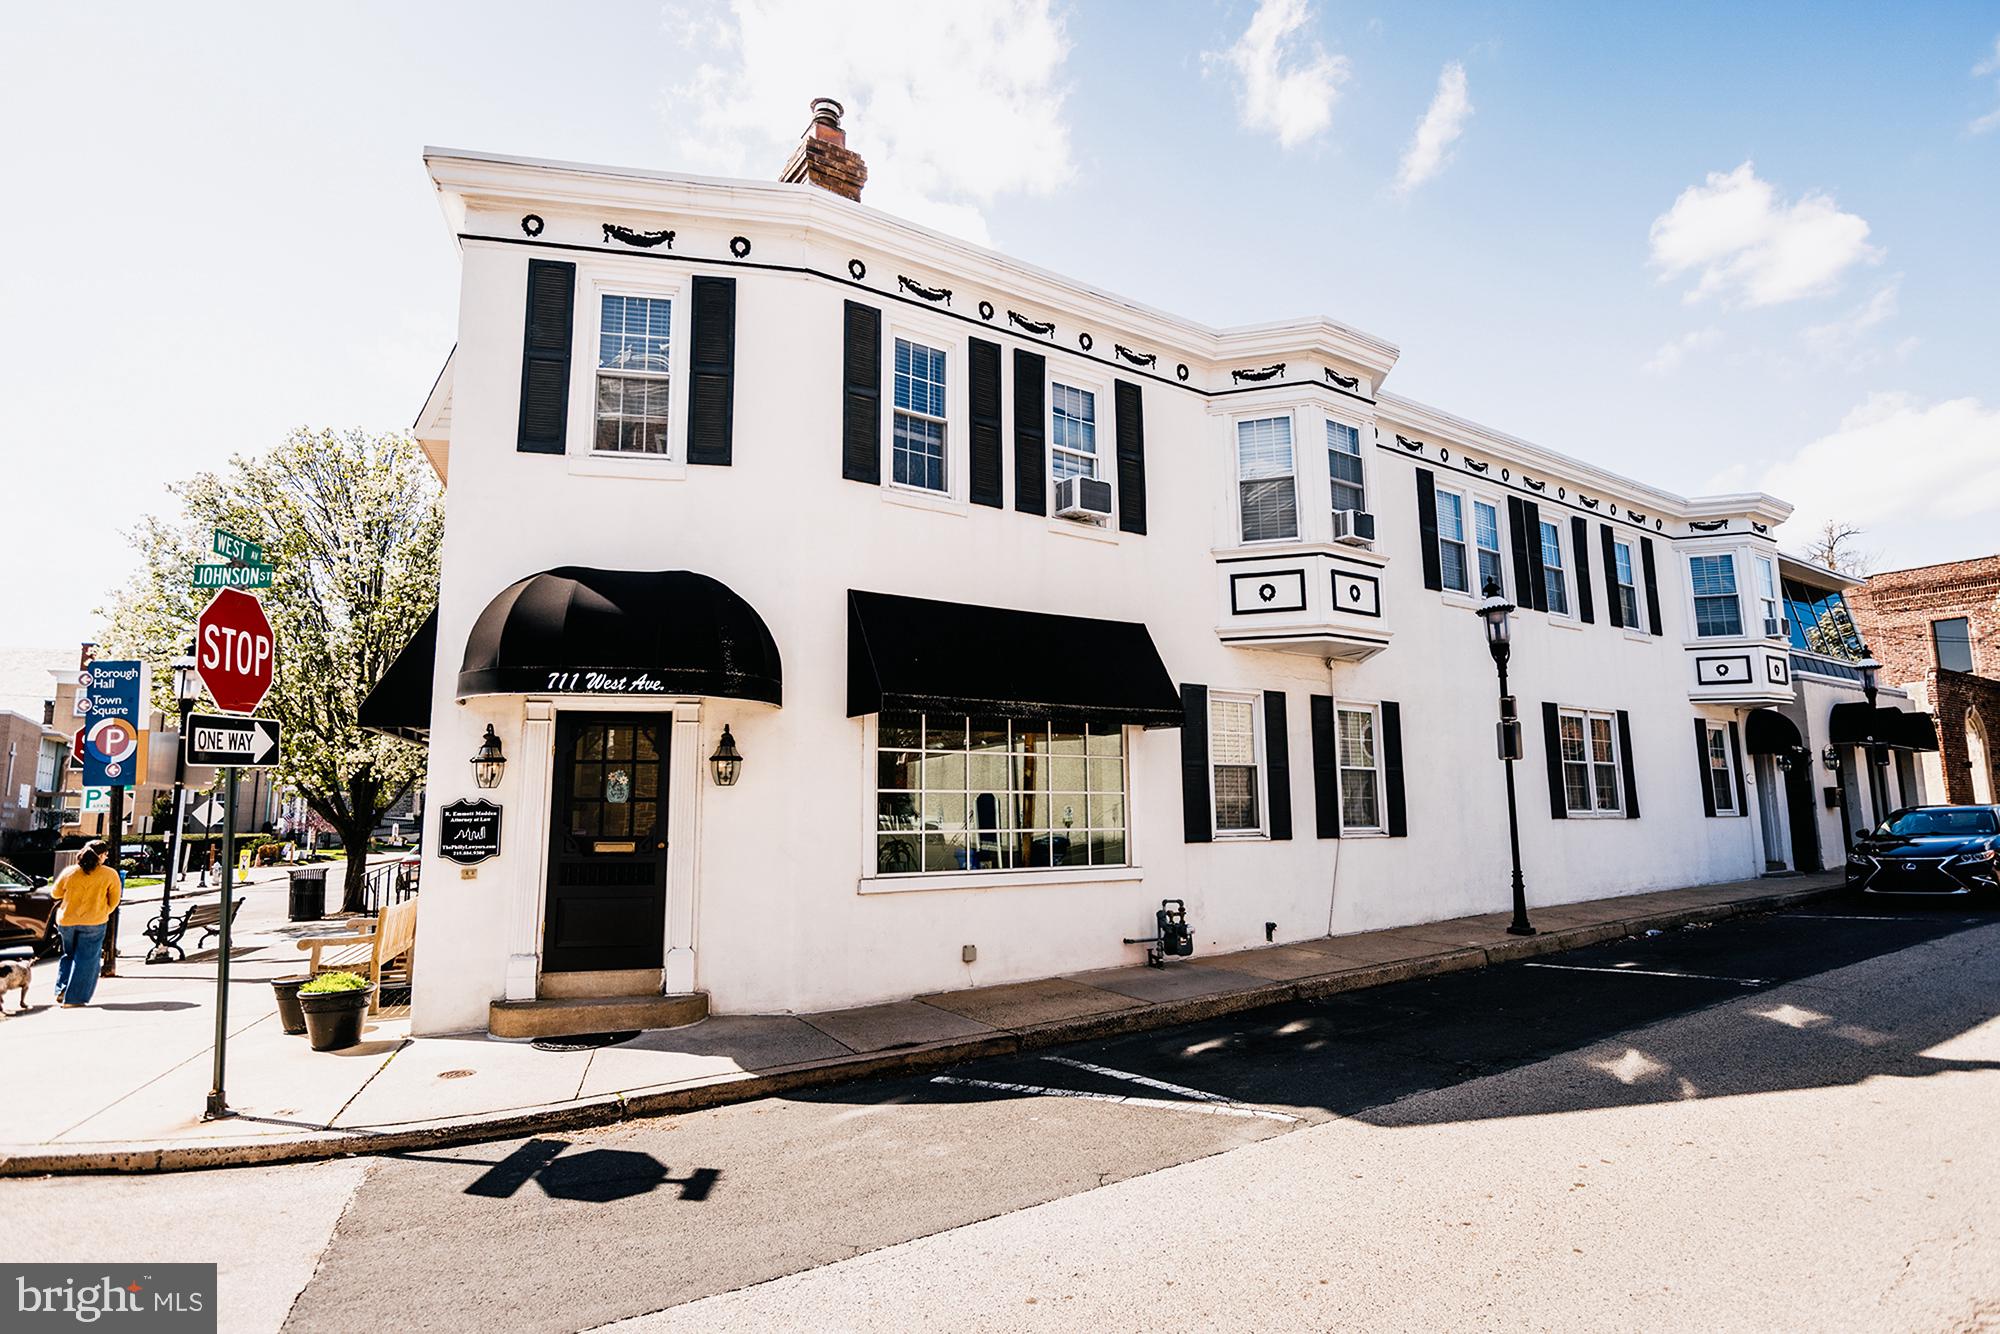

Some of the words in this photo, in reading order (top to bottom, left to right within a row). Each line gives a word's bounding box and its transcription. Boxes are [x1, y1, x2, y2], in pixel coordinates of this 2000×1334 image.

[217, 532, 247, 560] WEST
[251, 550, 259, 561] AV
[194, 567, 260, 585] JOHNSON
[260, 571, 271, 581] ST
[203, 624, 270, 677] STOP
[93, 667, 139, 681] Borough
[547, 672, 580, 690] 711
[585, 672, 627, 691] West
[628, 673, 665, 691] Ave.
[93, 678, 115, 689] Hall
[92, 694, 122, 705] Town
[91, 705, 129, 718] Square
[105, 728, 125, 755] P
[198, 730, 224, 750] ONE
[228, 732, 254, 751] WAY
